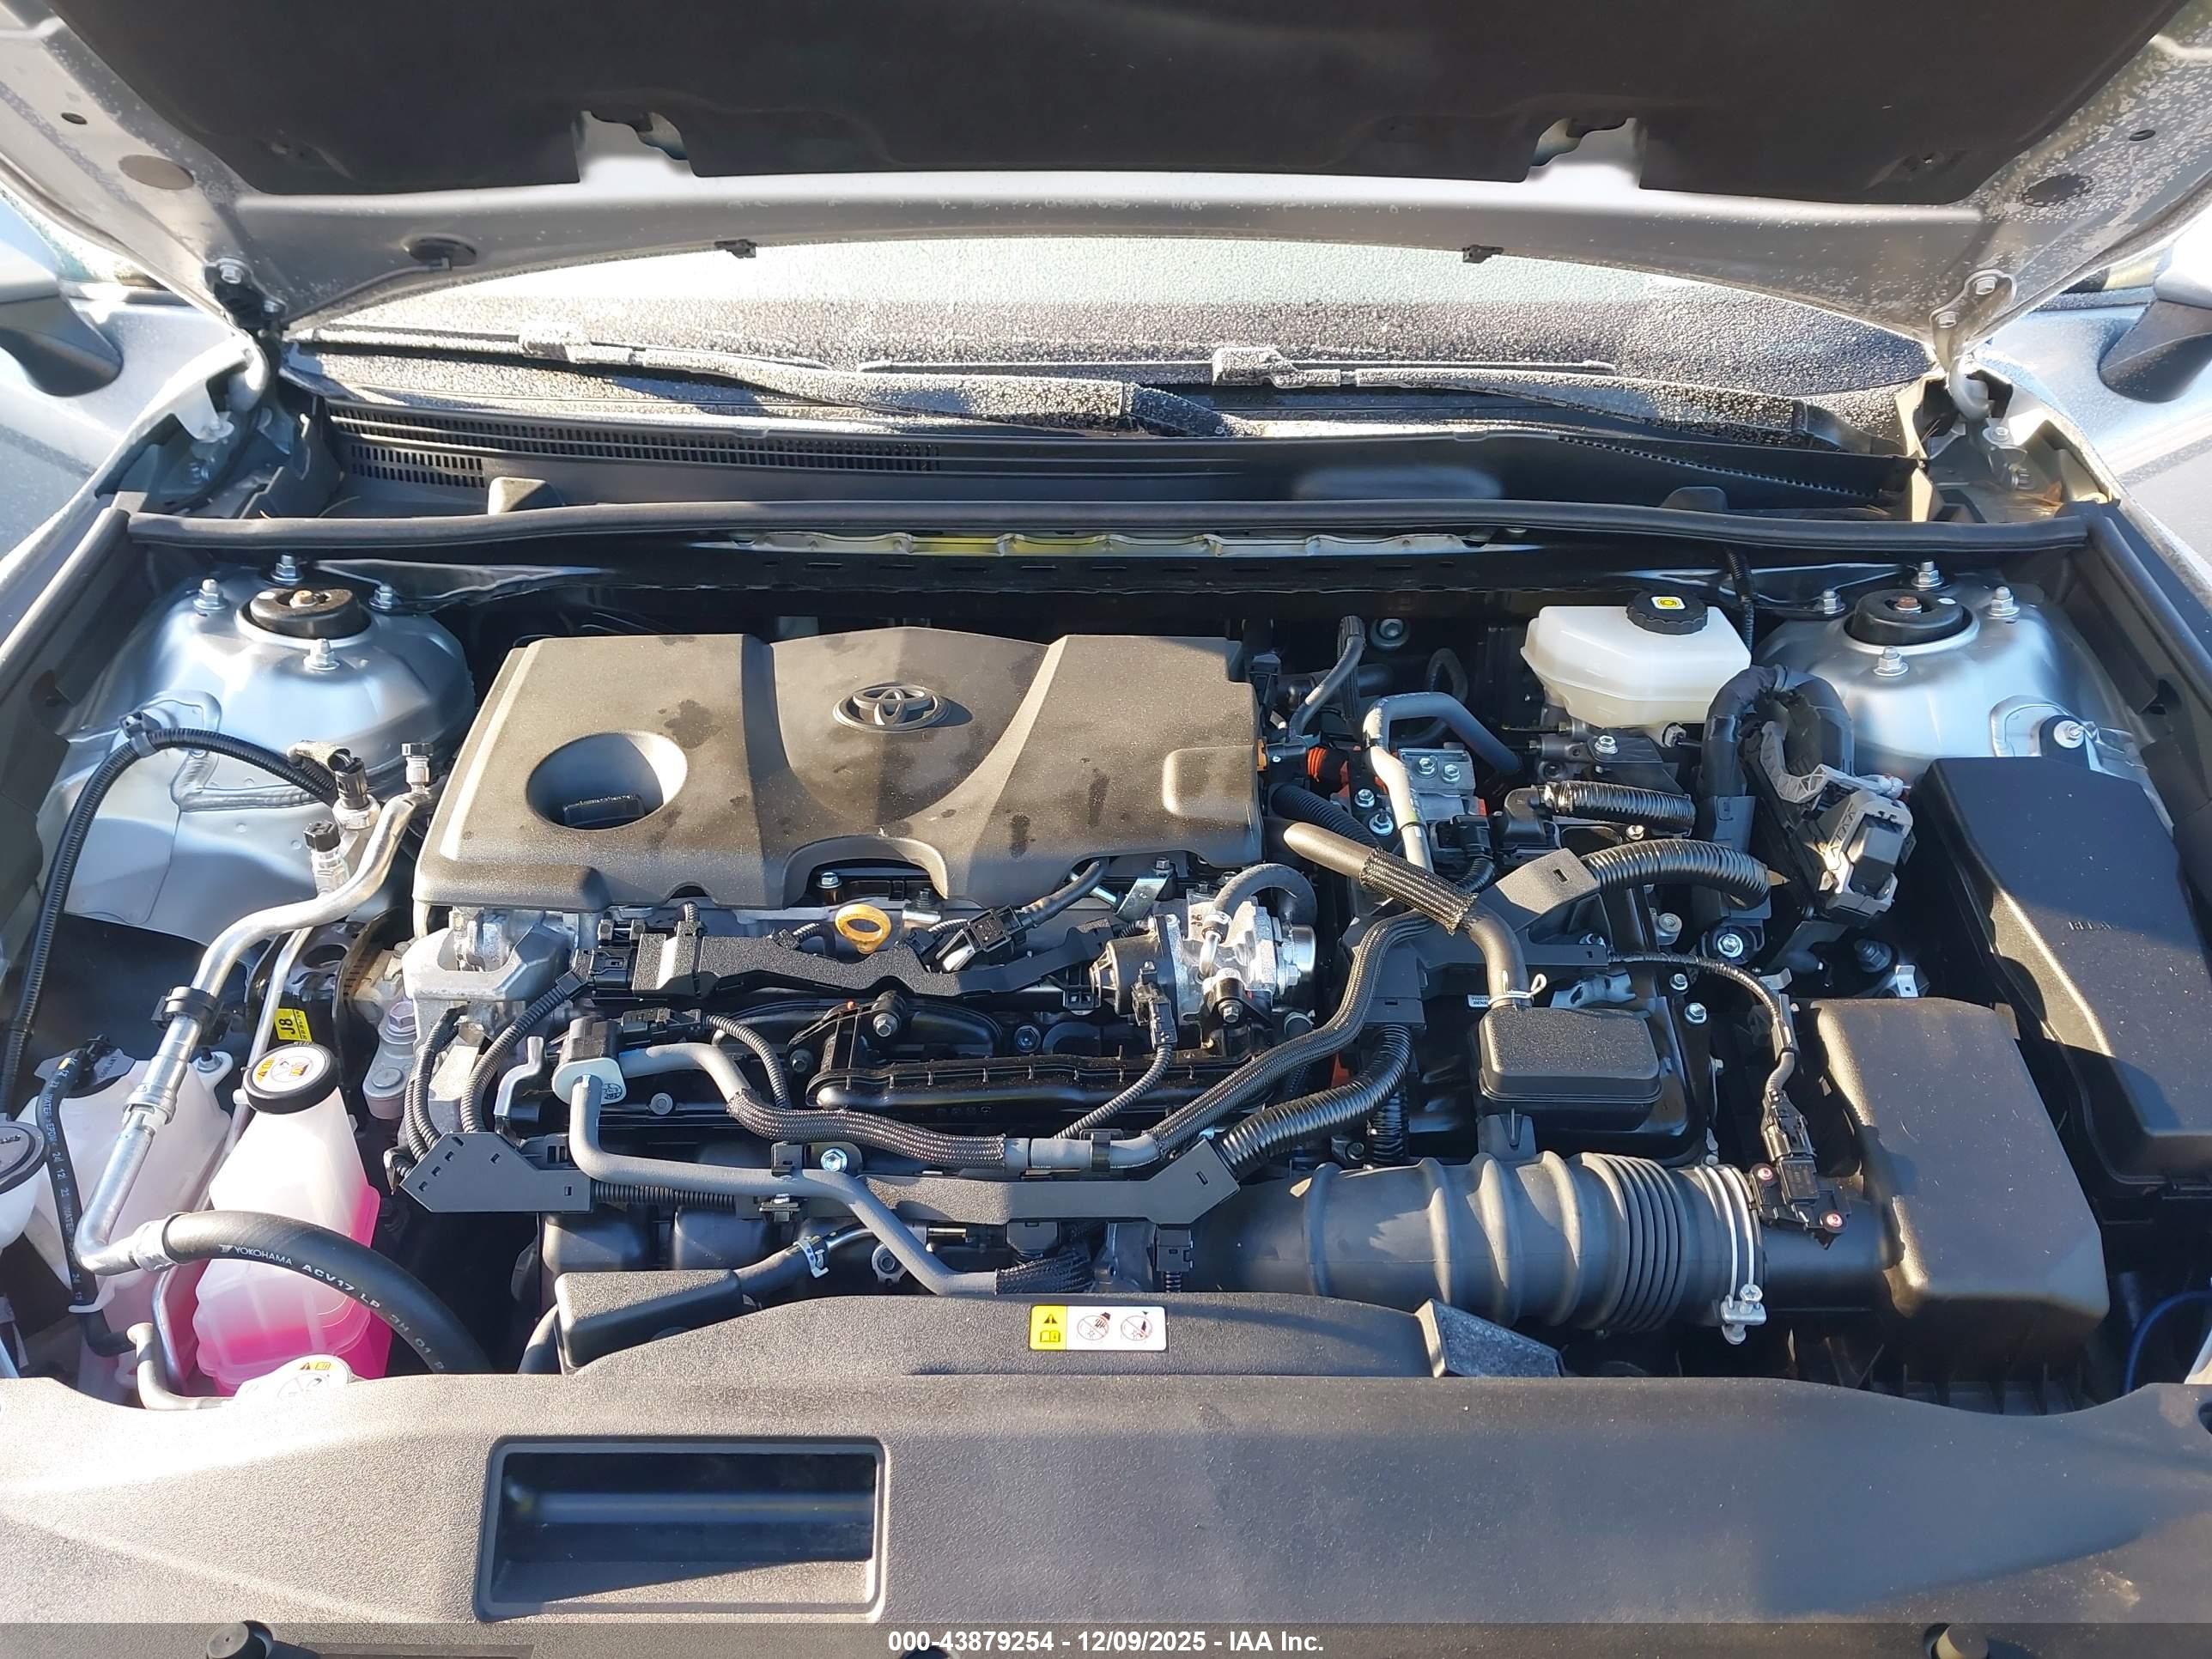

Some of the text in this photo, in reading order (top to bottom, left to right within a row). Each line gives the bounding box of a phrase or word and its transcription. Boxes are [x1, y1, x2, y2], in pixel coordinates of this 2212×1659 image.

[279, 1018, 295, 1035] J8
[234, 1244, 293, 1265] YOKOHAMA
[301, 1264, 355, 1291] ACV17
[360, 1293, 380, 1308] LP
